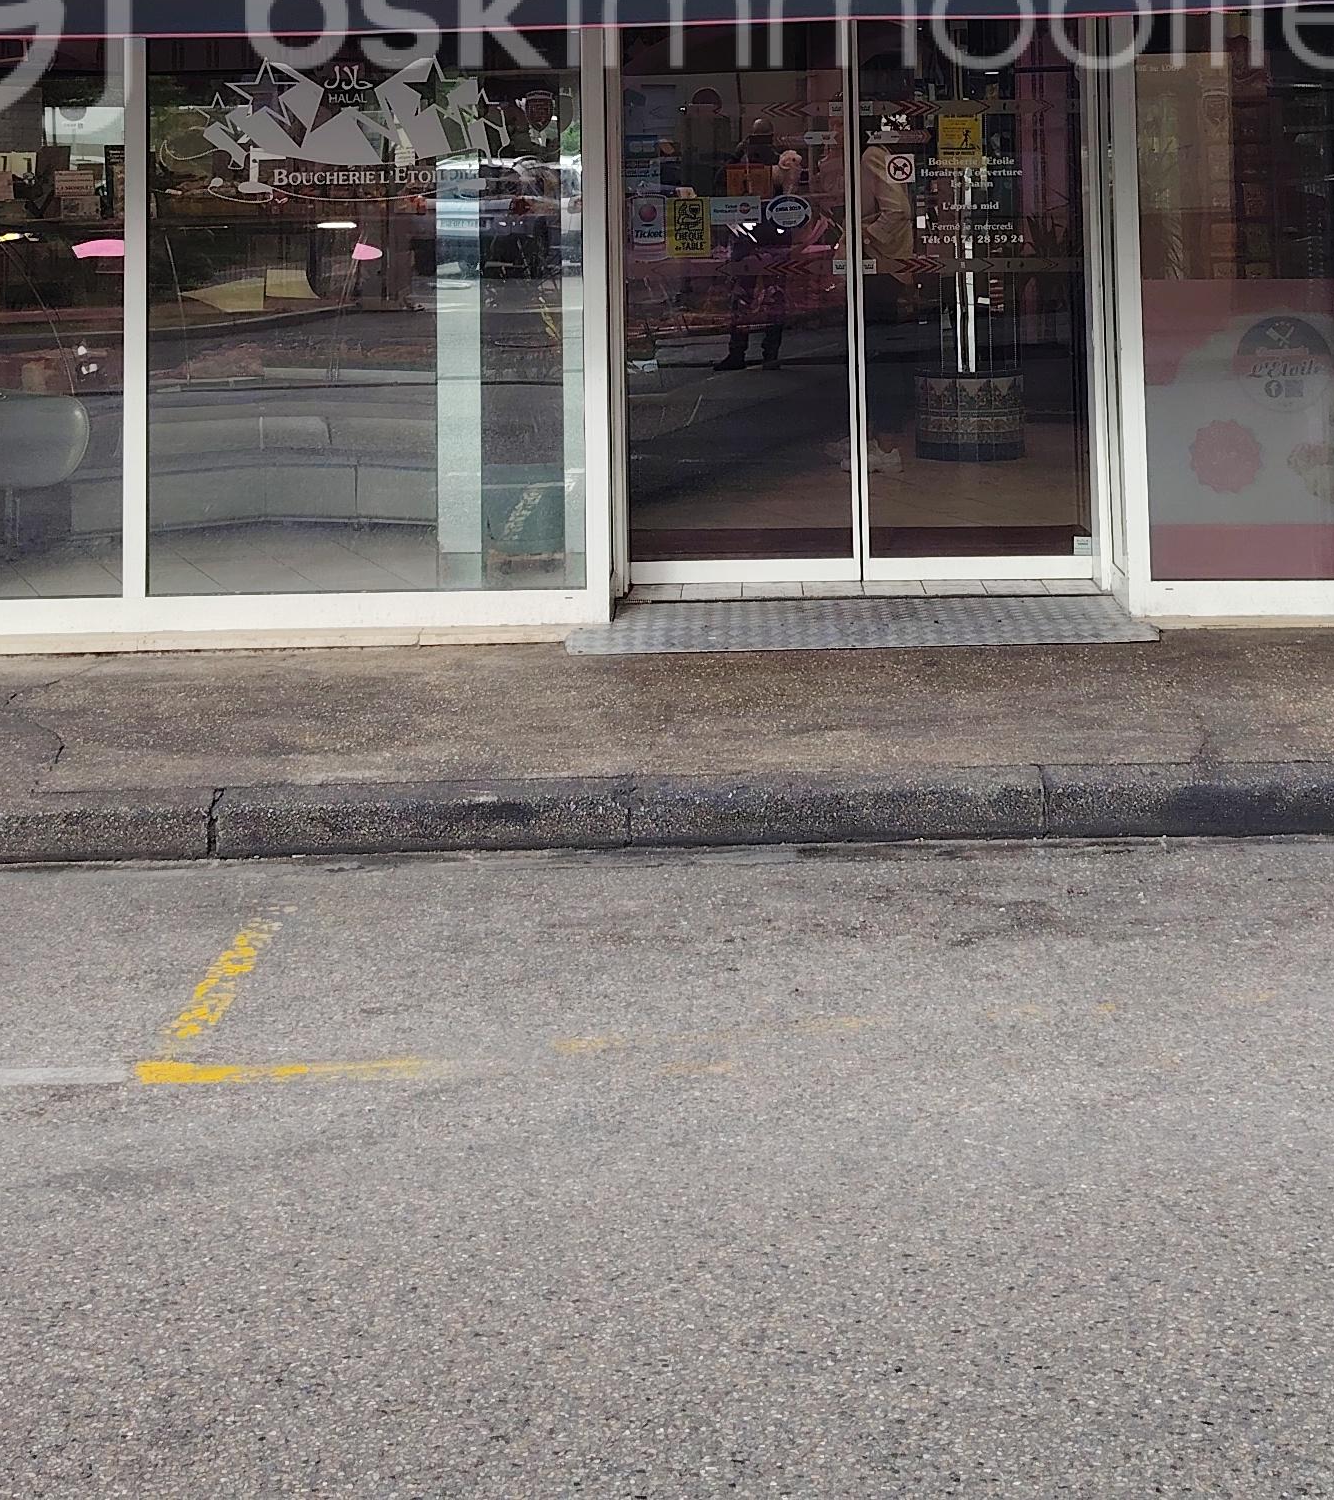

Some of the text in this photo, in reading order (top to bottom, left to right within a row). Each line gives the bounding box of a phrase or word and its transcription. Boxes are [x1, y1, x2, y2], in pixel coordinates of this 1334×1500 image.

[324, 65, 373, 91] حلال
[328, 93, 367, 104] HALAL
[273, 169, 376, 186] BOUCHERIE
[920, 168, 1023, 177] Horaires 'overture
[931, 222, 960, 231] Fermé
[974, 221, 1013, 231] mercredi
[634, 229, 663, 238] Ticket
[943, 235, 957, 244] 04
[977, 235, 990, 244] 28
[994, 235, 1008, 244] 59
[1011, 235, 1024, 243] 24
